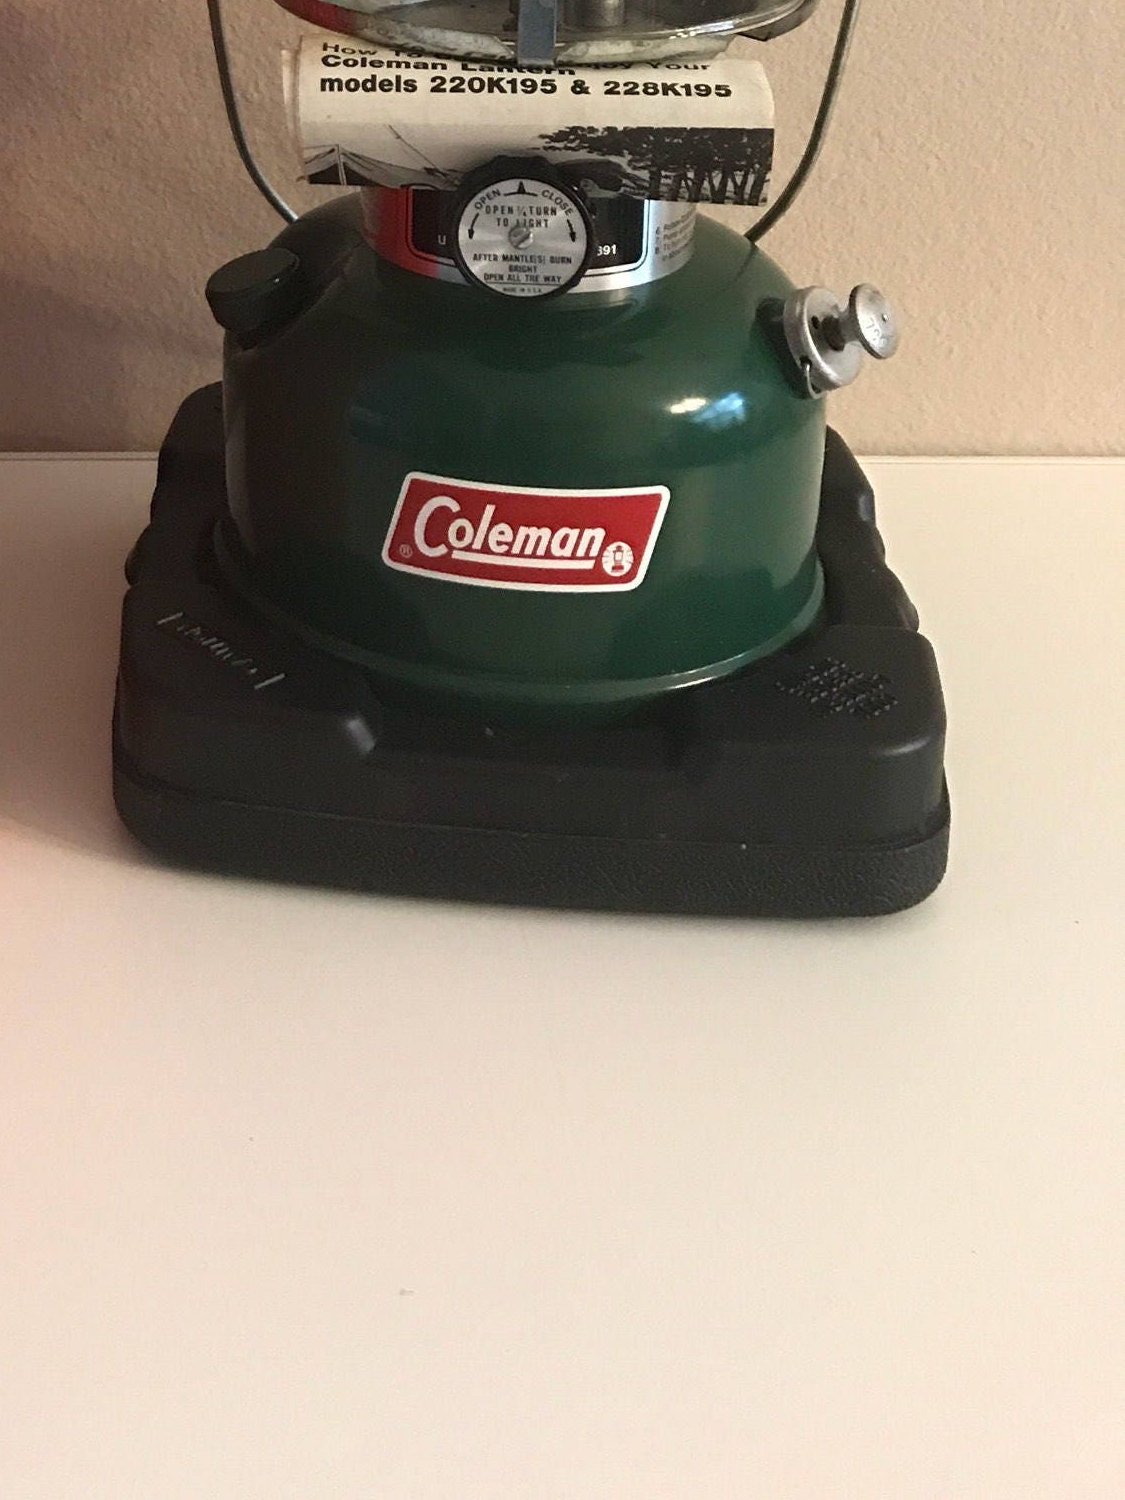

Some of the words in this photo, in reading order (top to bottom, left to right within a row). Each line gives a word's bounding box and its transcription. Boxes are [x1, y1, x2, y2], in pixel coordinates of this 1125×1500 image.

[322, 42, 377, 56] How
[321, 54, 448, 71] Coleman
[320, 74, 418, 93] models
[429, 75, 558, 95] 220K195
[570, 79, 591, 95] &
[603, 80, 733, 98] 228K195
[475, 188, 502, 211] OPEN
[541, 189, 574, 216] CLOSE
[485, 204, 514, 215] OPEN
[528, 205, 558, 217] TURN
[496, 217, 510, 228] TO
[472, 252, 499, 262] AFTER
[549, 256, 573, 265] BURN
[483, 273, 505, 281] OPEN
[506, 274, 522, 282] ALL
[543, 275, 562, 284] WAY
[413, 495, 606, 558] Coleman
